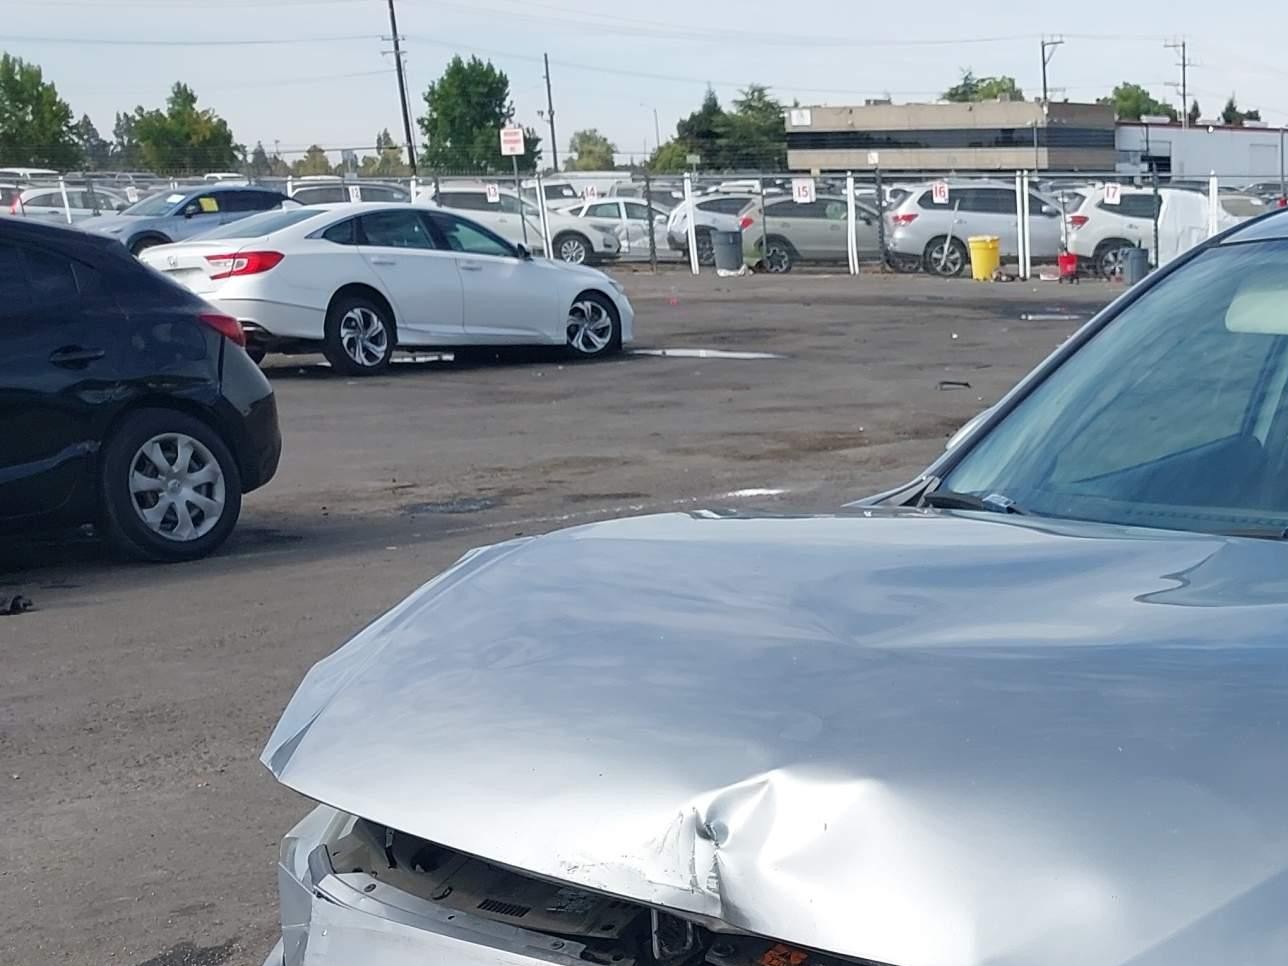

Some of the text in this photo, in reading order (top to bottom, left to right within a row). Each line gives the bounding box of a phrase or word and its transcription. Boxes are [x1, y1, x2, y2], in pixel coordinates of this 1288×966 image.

[797, 186, 809, 198] 15
[934, 186, 946, 198] 16
[1106, 186, 1118, 199] 17
